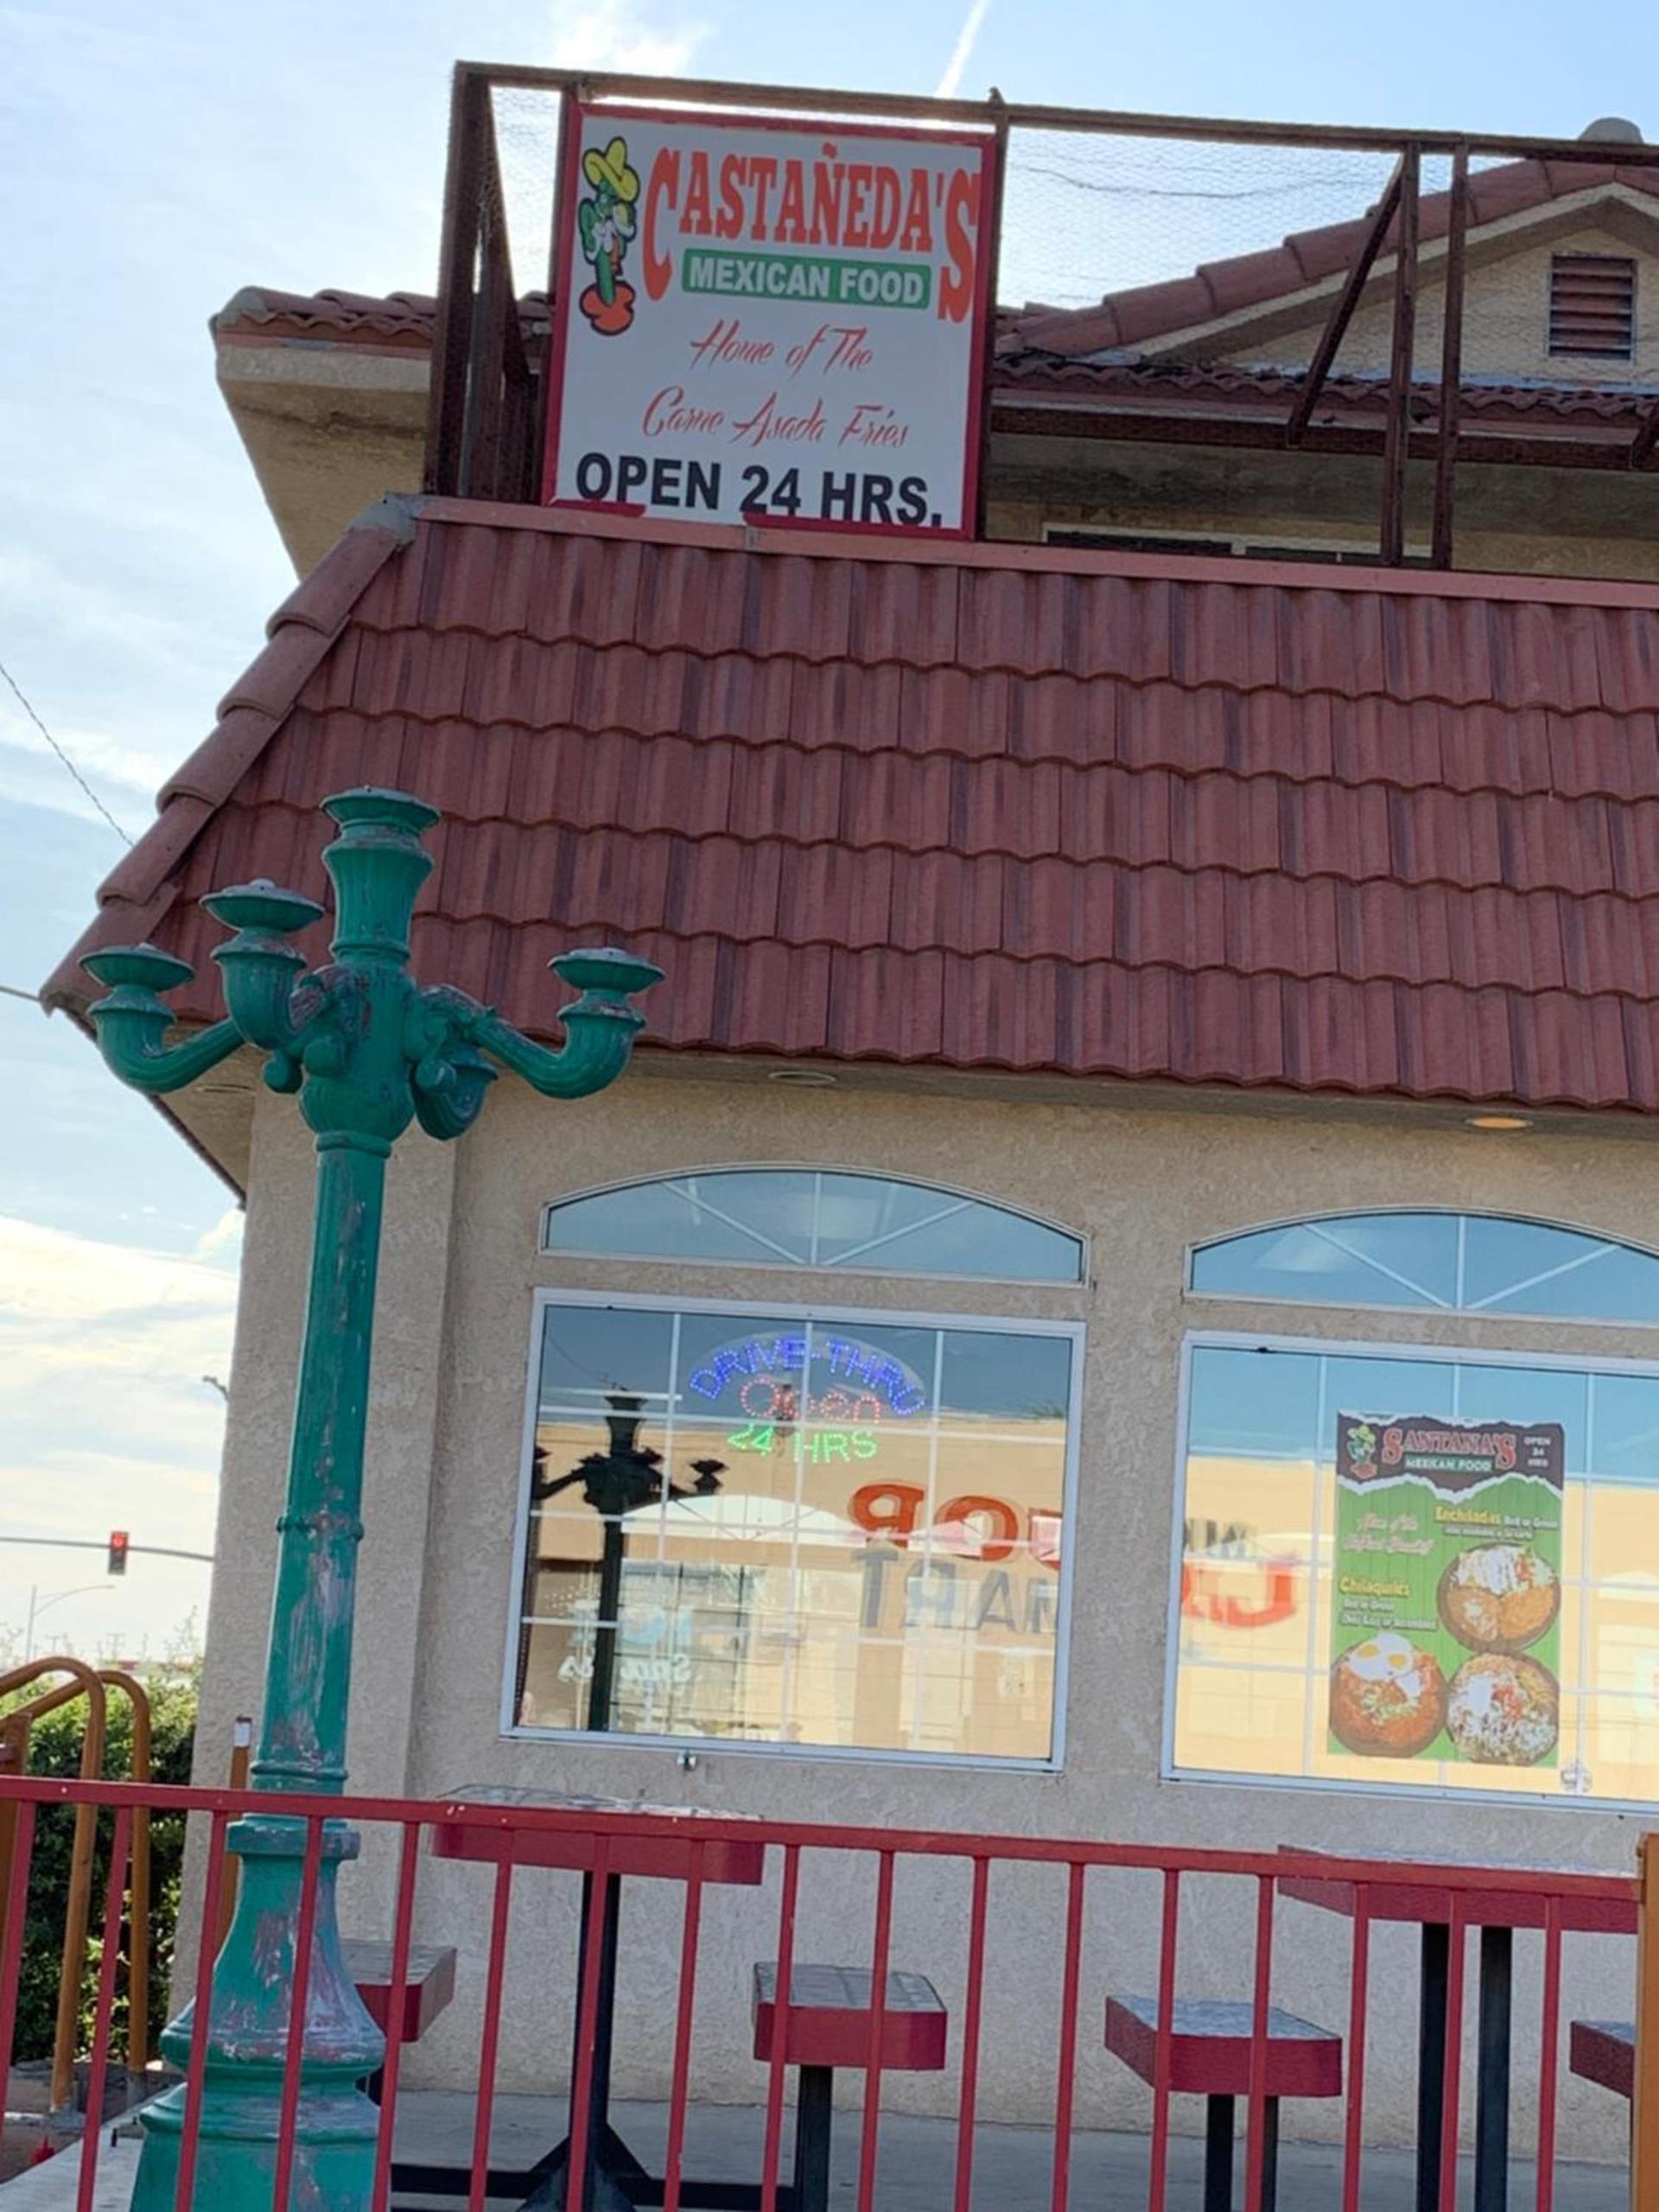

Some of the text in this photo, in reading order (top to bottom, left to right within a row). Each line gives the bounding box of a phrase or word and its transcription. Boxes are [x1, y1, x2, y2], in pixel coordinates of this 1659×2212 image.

[642, 142, 982, 324] CASTAÑEDA'S
[690, 257, 924, 305] MEXICAN FOOD
[690, 319, 873, 380] Home of The
[641, 385, 910, 448] Carne Asada Fries
[575, 452, 944, 528] OPEN 24 HRS.
[727, 1422, 878, 1464] 24 HRS
[1404, 1458, 1492, 1472] MEXICAN FOOD
[1523, 1436, 1552, 1446] OPEN
